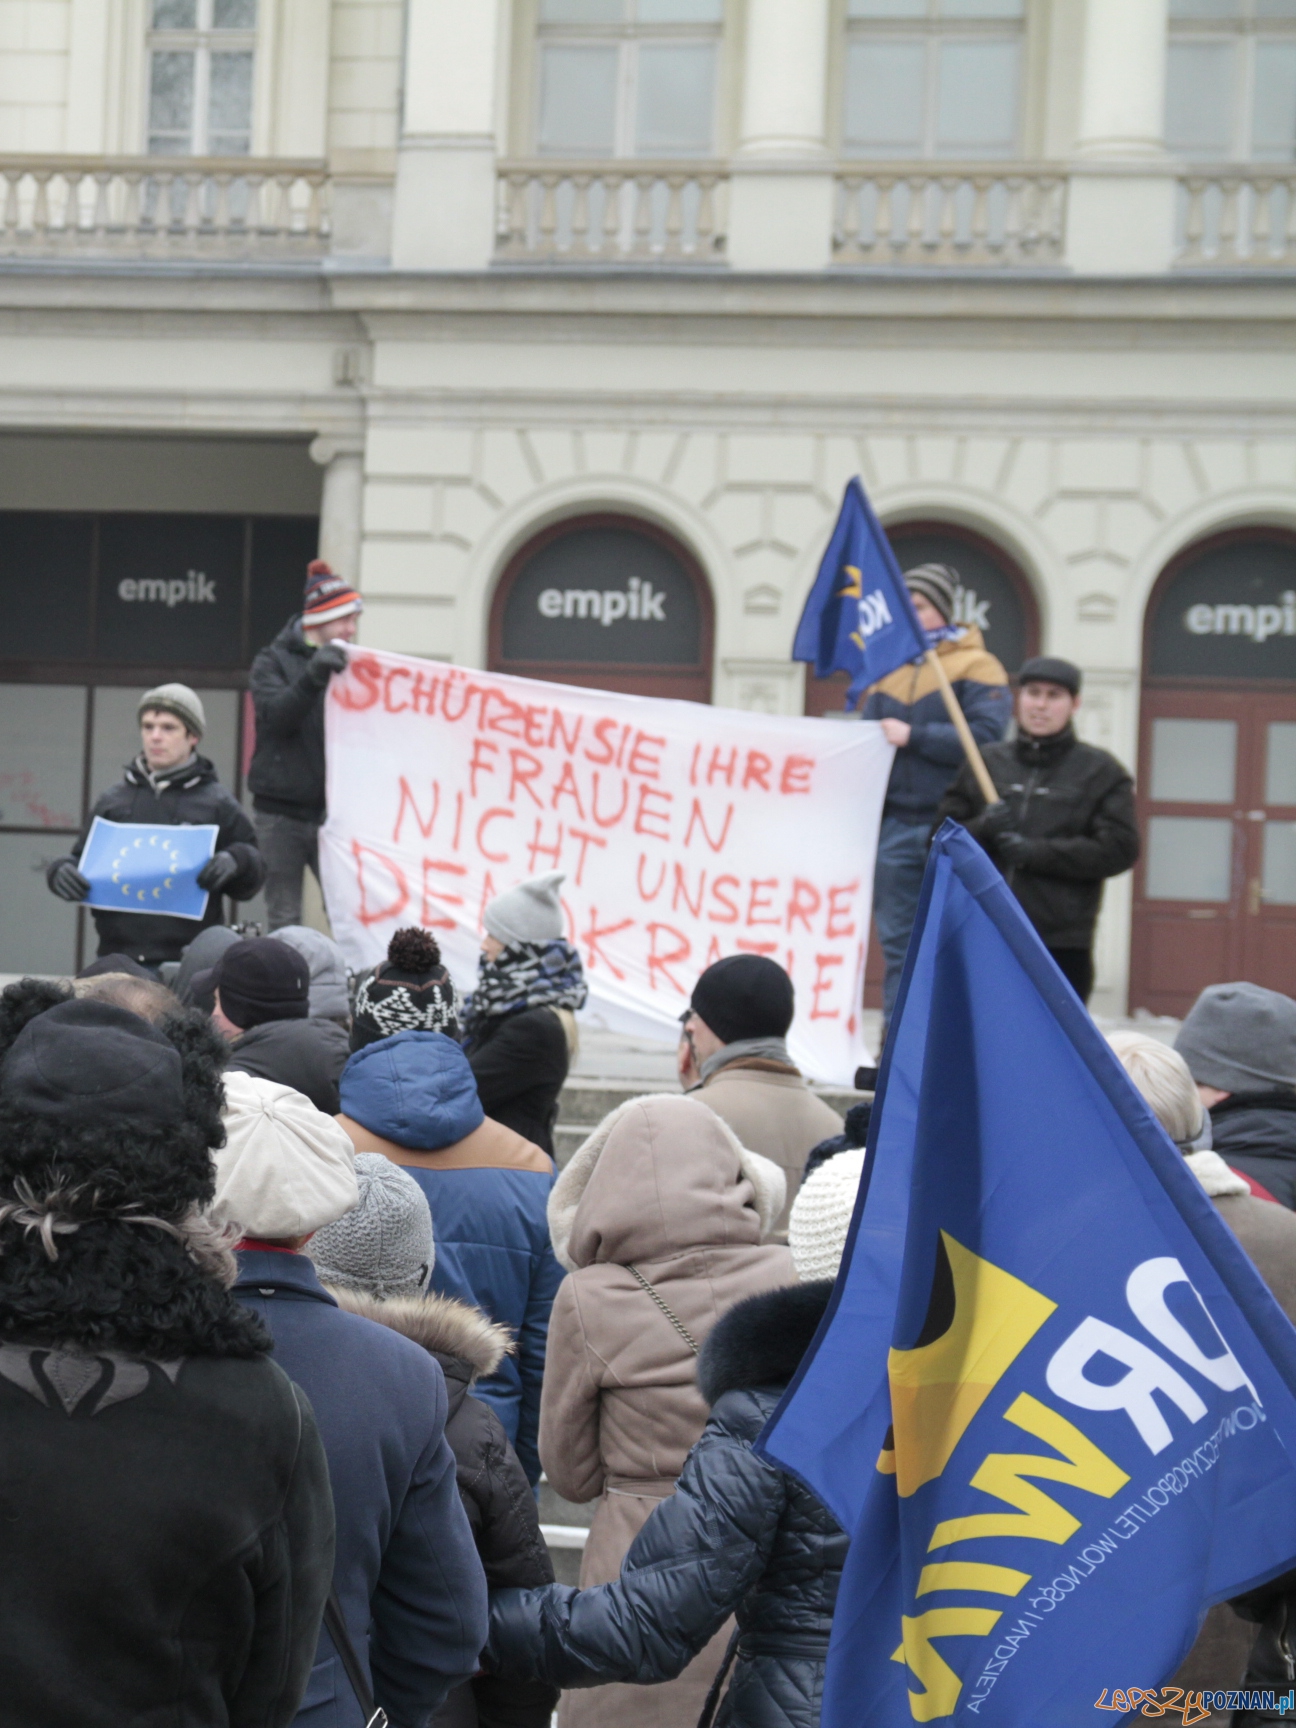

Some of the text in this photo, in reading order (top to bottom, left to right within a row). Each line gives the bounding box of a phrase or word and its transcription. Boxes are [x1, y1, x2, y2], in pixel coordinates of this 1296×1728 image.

[118, 569, 217, 607] empik
[537, 576, 667, 627] empik
[1185, 589, 1296, 642] empi
[331, 652, 815, 794] SCHÜTZEN SIE IHRE
[469, 737, 734, 853] FRAUEN
[392, 775, 861, 939] NICHT UNSERE
